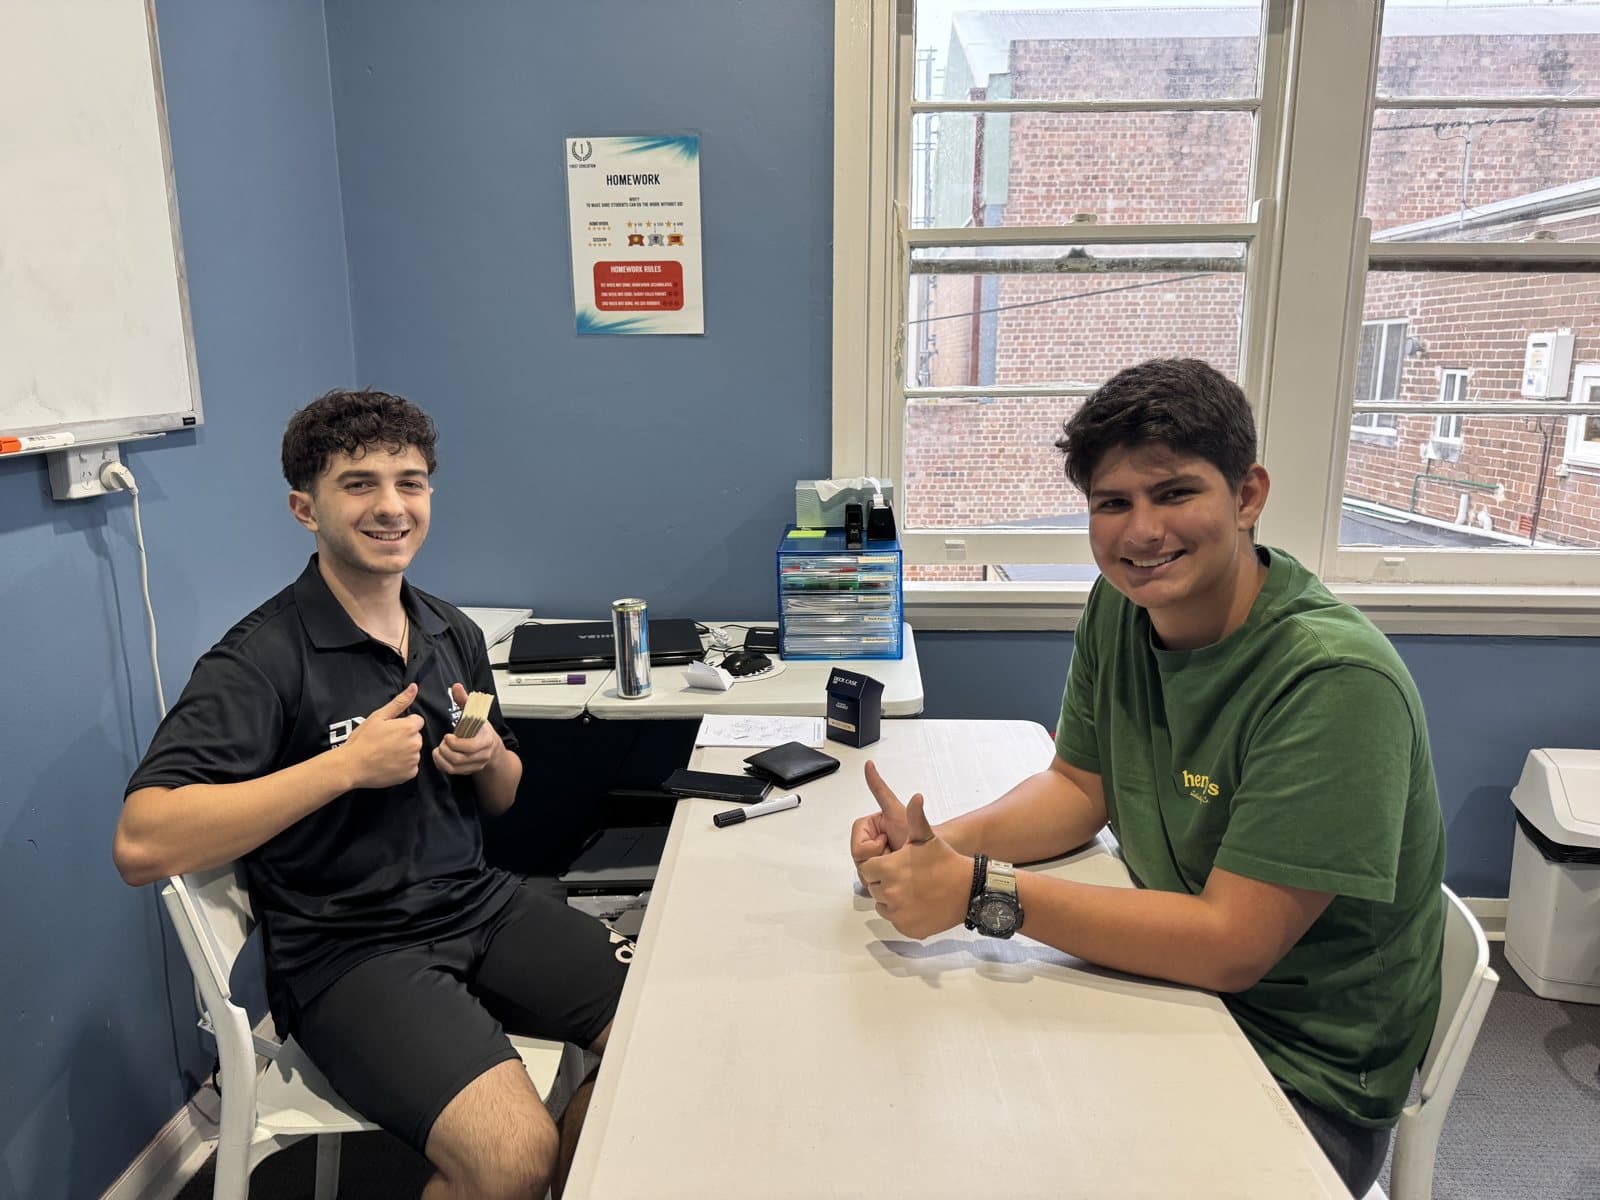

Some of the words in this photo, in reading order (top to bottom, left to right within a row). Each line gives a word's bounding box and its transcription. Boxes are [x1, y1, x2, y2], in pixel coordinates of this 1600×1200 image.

[606, 174, 661, 186] HOMEWORK
[610, 265, 643, 273] HOMEWORK
[643, 265, 661, 273] RULES
